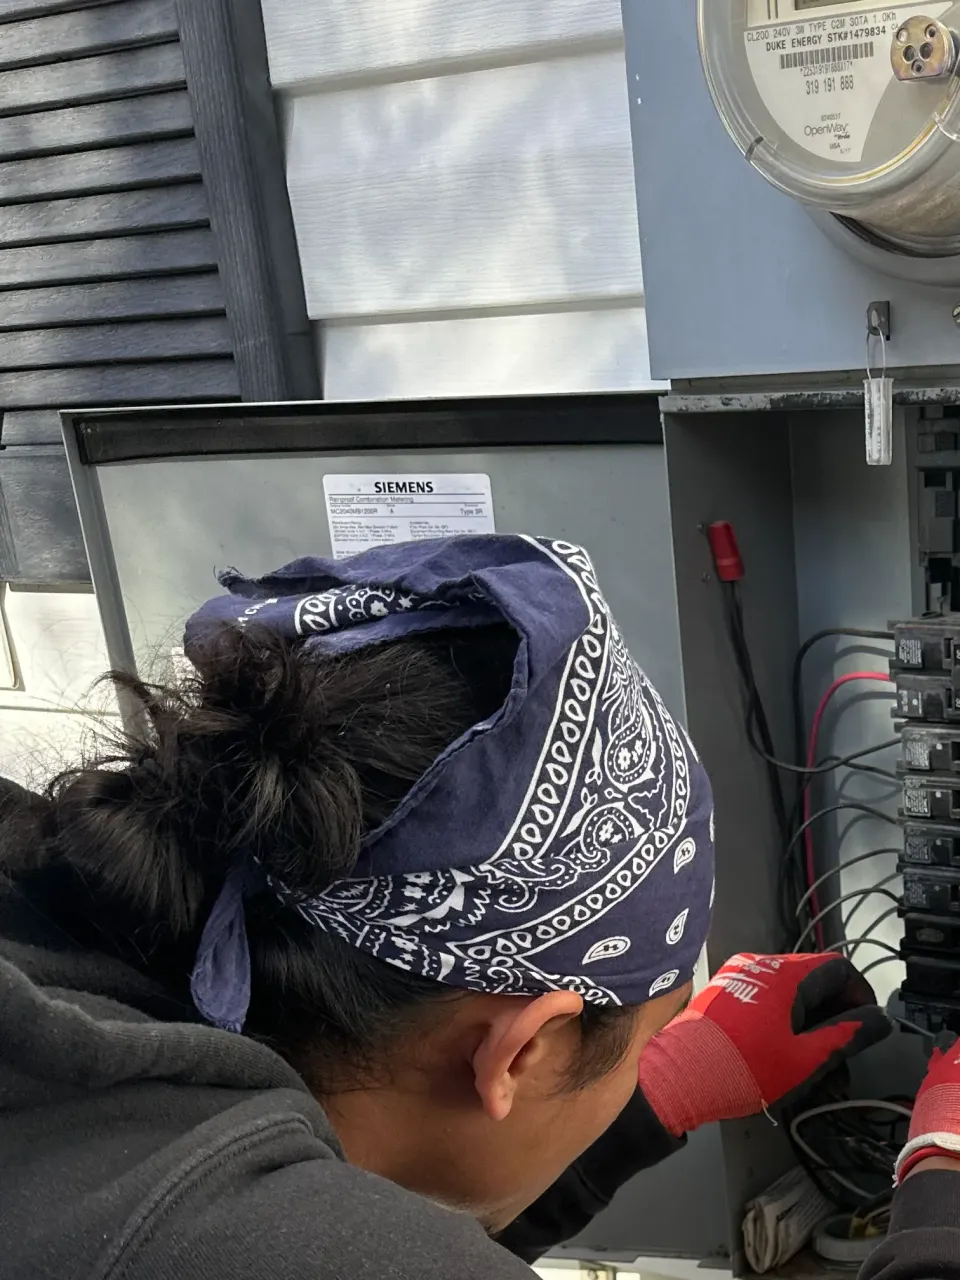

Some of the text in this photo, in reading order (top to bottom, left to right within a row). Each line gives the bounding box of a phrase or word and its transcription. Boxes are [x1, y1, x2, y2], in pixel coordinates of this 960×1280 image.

[747, 30, 769, 42] CL200
[773, 27, 791, 39] 240V
[809, 21, 827, 33] TYPE
[766, 25, 886, 51] DUKE ENERGY STK#1479834
[806, 75, 853, 95] 319 191 888
[804, 123, 846, 137] OpenWay
[374, 481, 434, 494] SIEMENS
